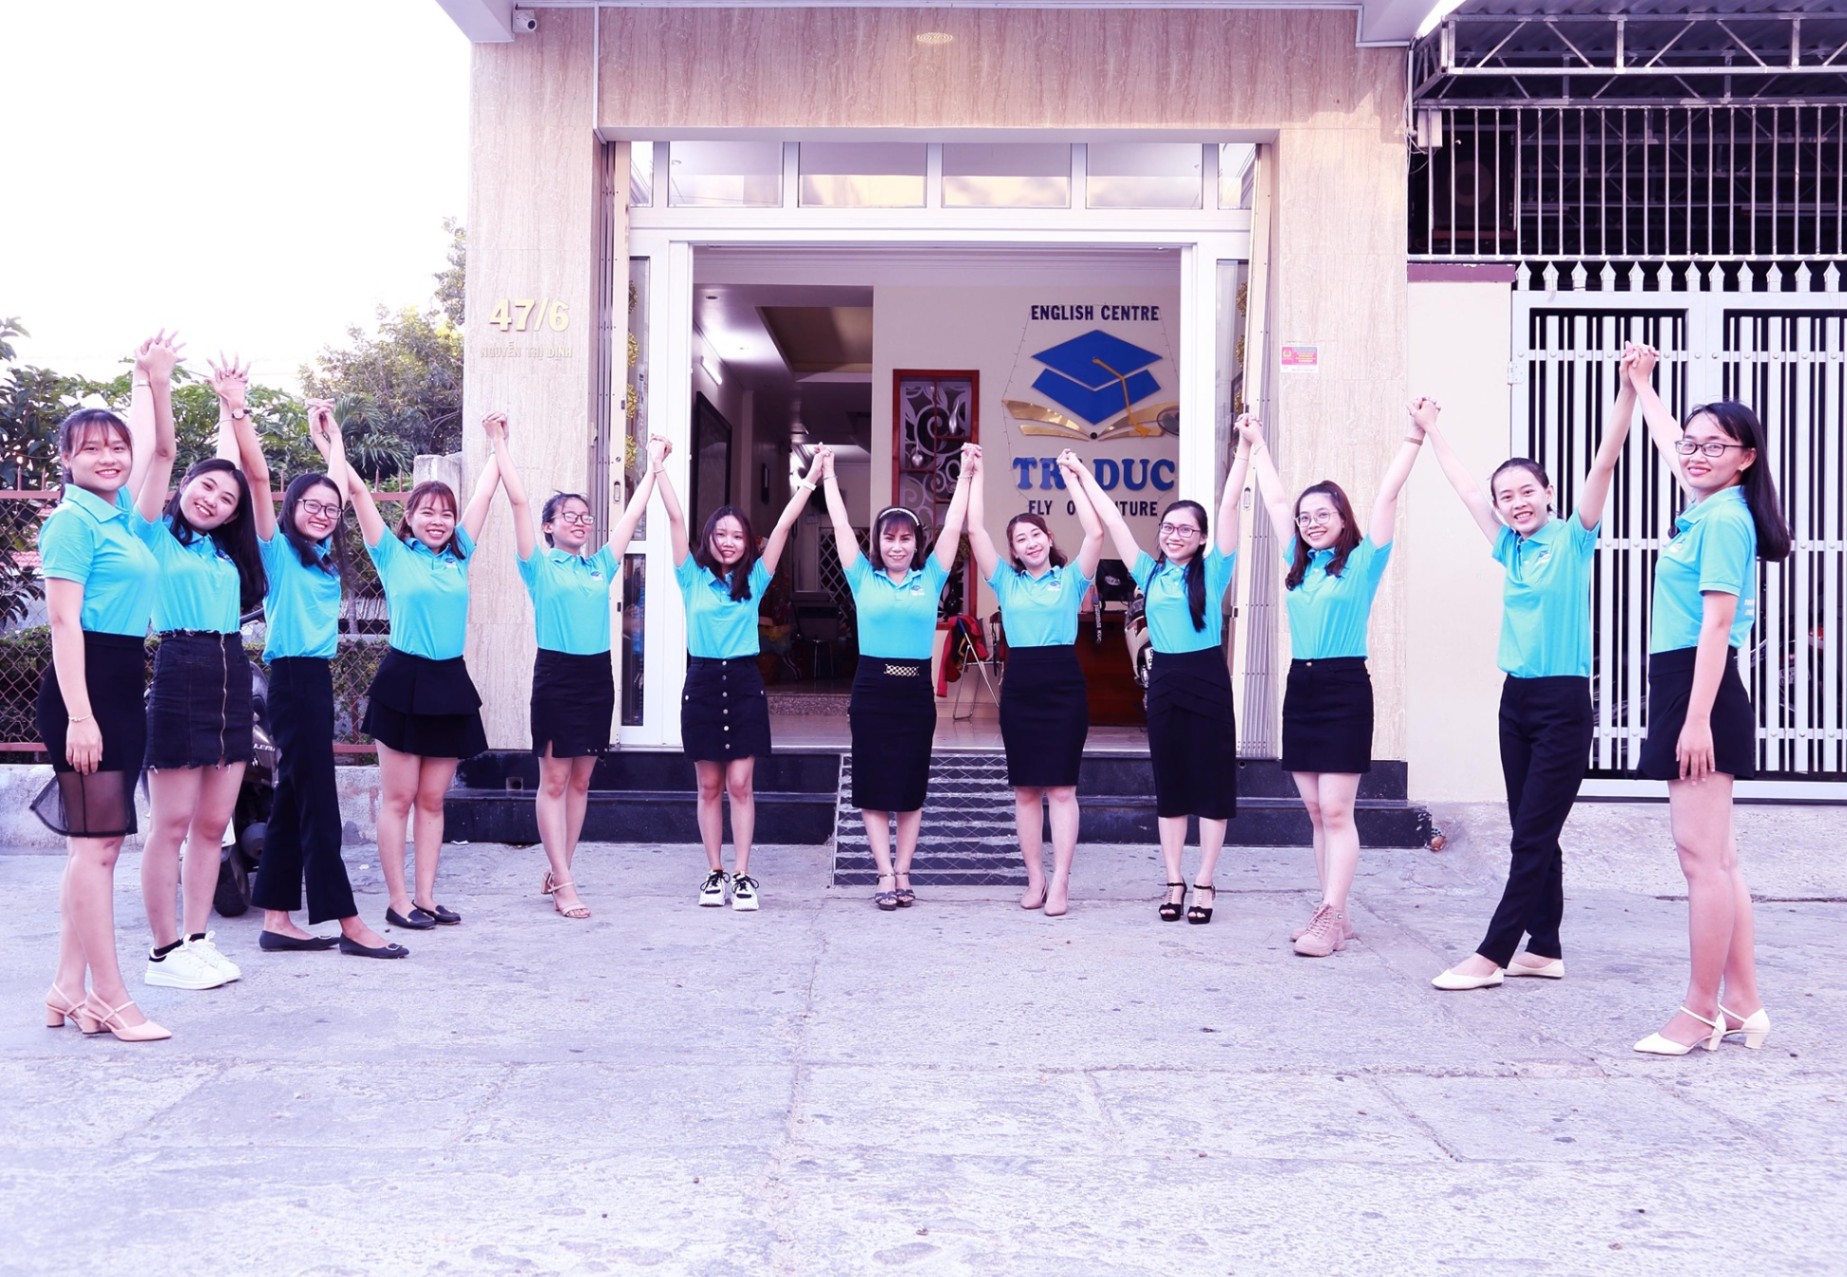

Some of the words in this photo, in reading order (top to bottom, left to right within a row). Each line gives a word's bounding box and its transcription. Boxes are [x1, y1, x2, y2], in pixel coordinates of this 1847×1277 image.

[489, 297, 570, 332] 47/6
[1031, 305, 1094, 320] ENGLISH
[1101, 305, 1160, 321] CENTRE
[1012, 456, 1083, 491] TR
[1093, 458, 1176, 491] DUC
[1029, 500, 1053, 516] FLY
[1115, 501, 1158, 516] TURE
